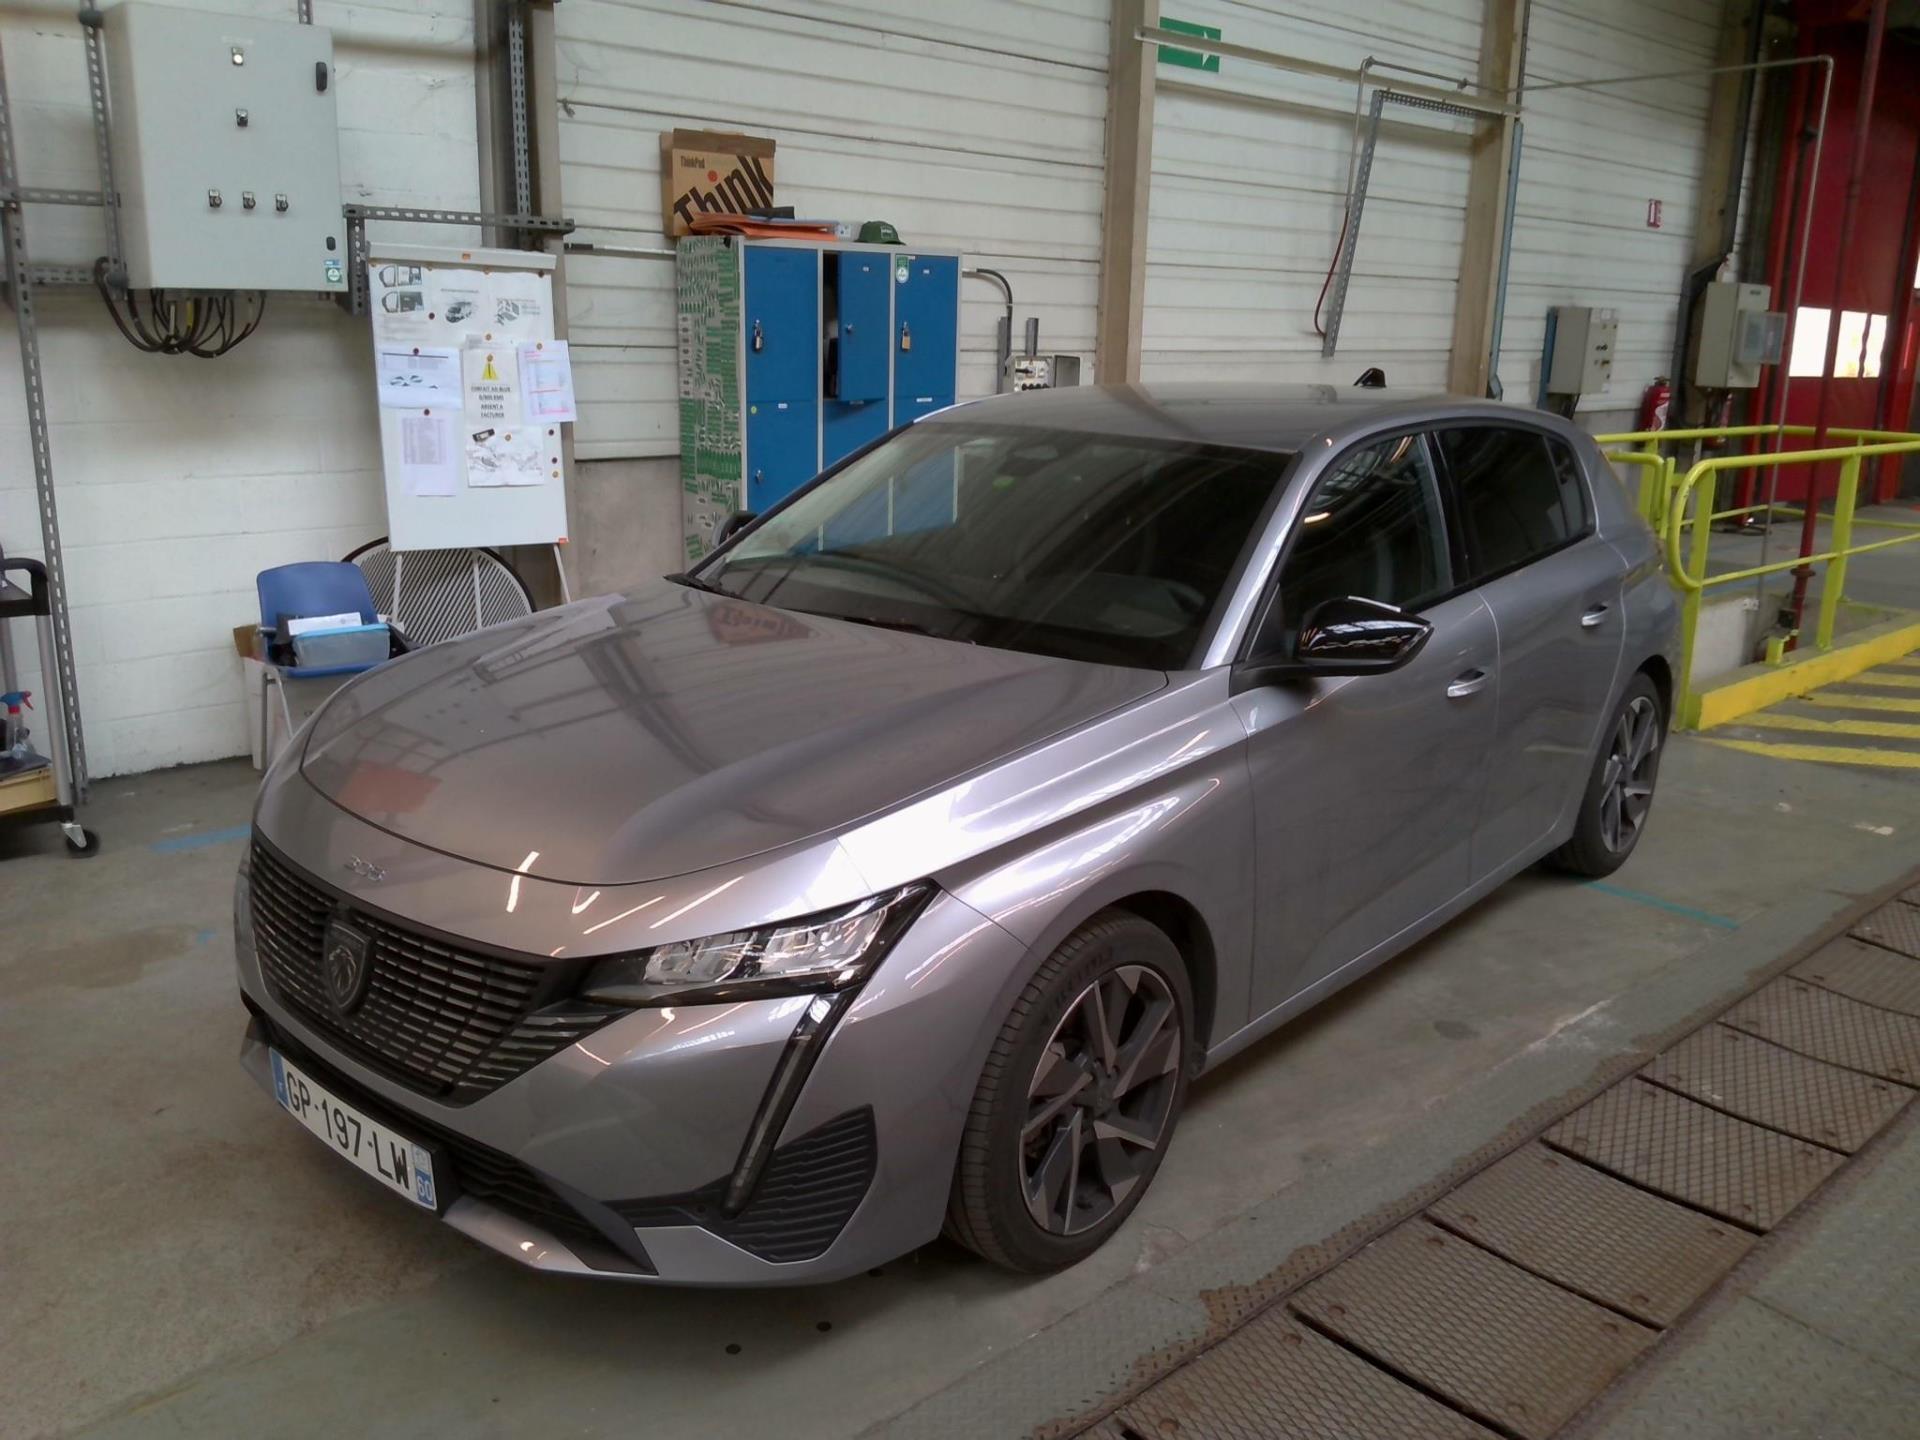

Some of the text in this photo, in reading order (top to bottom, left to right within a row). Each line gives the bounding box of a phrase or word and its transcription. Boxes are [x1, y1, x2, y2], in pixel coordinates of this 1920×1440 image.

[680, 155, 705, 169] ThinkPad
[673, 154, 774, 226] Think
[416, 1175, 434, 1203] 60
